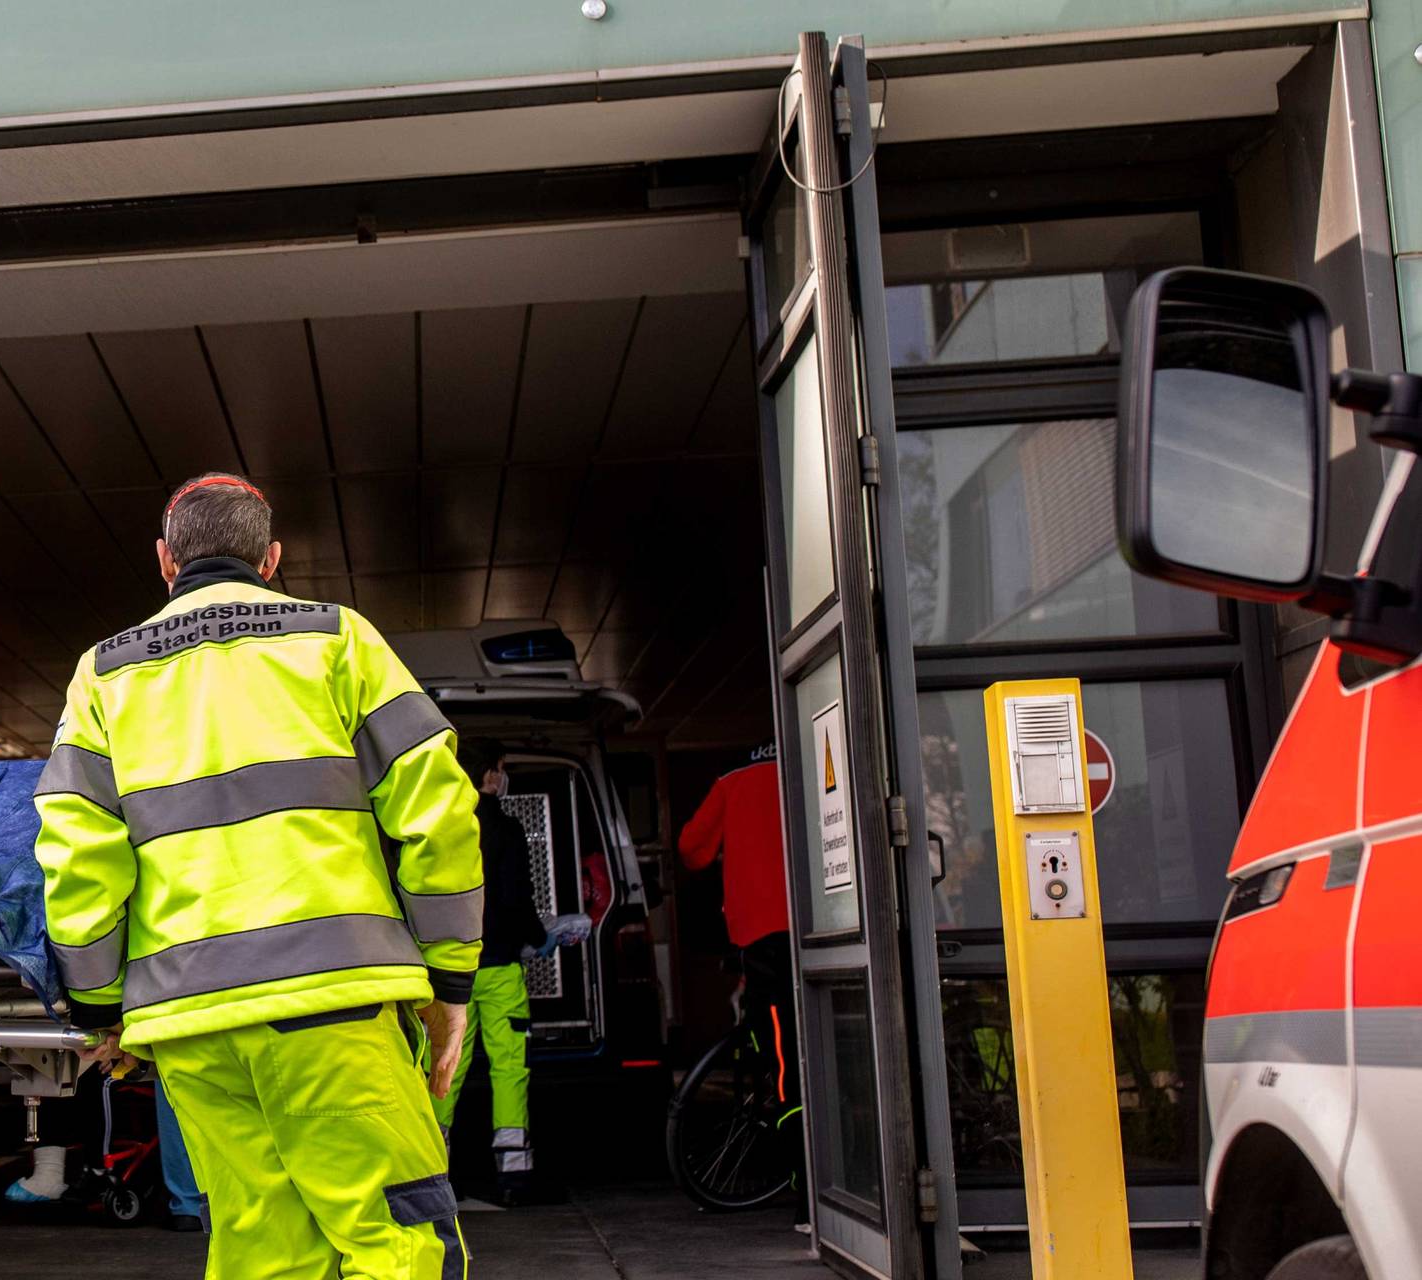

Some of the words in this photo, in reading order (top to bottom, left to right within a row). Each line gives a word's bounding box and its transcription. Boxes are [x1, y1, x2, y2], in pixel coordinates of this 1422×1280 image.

[100, 603, 333, 655] RETTUNGSDIENST
[146, 624, 211, 655] Stadt
[218, 619, 283, 638] Bonn
